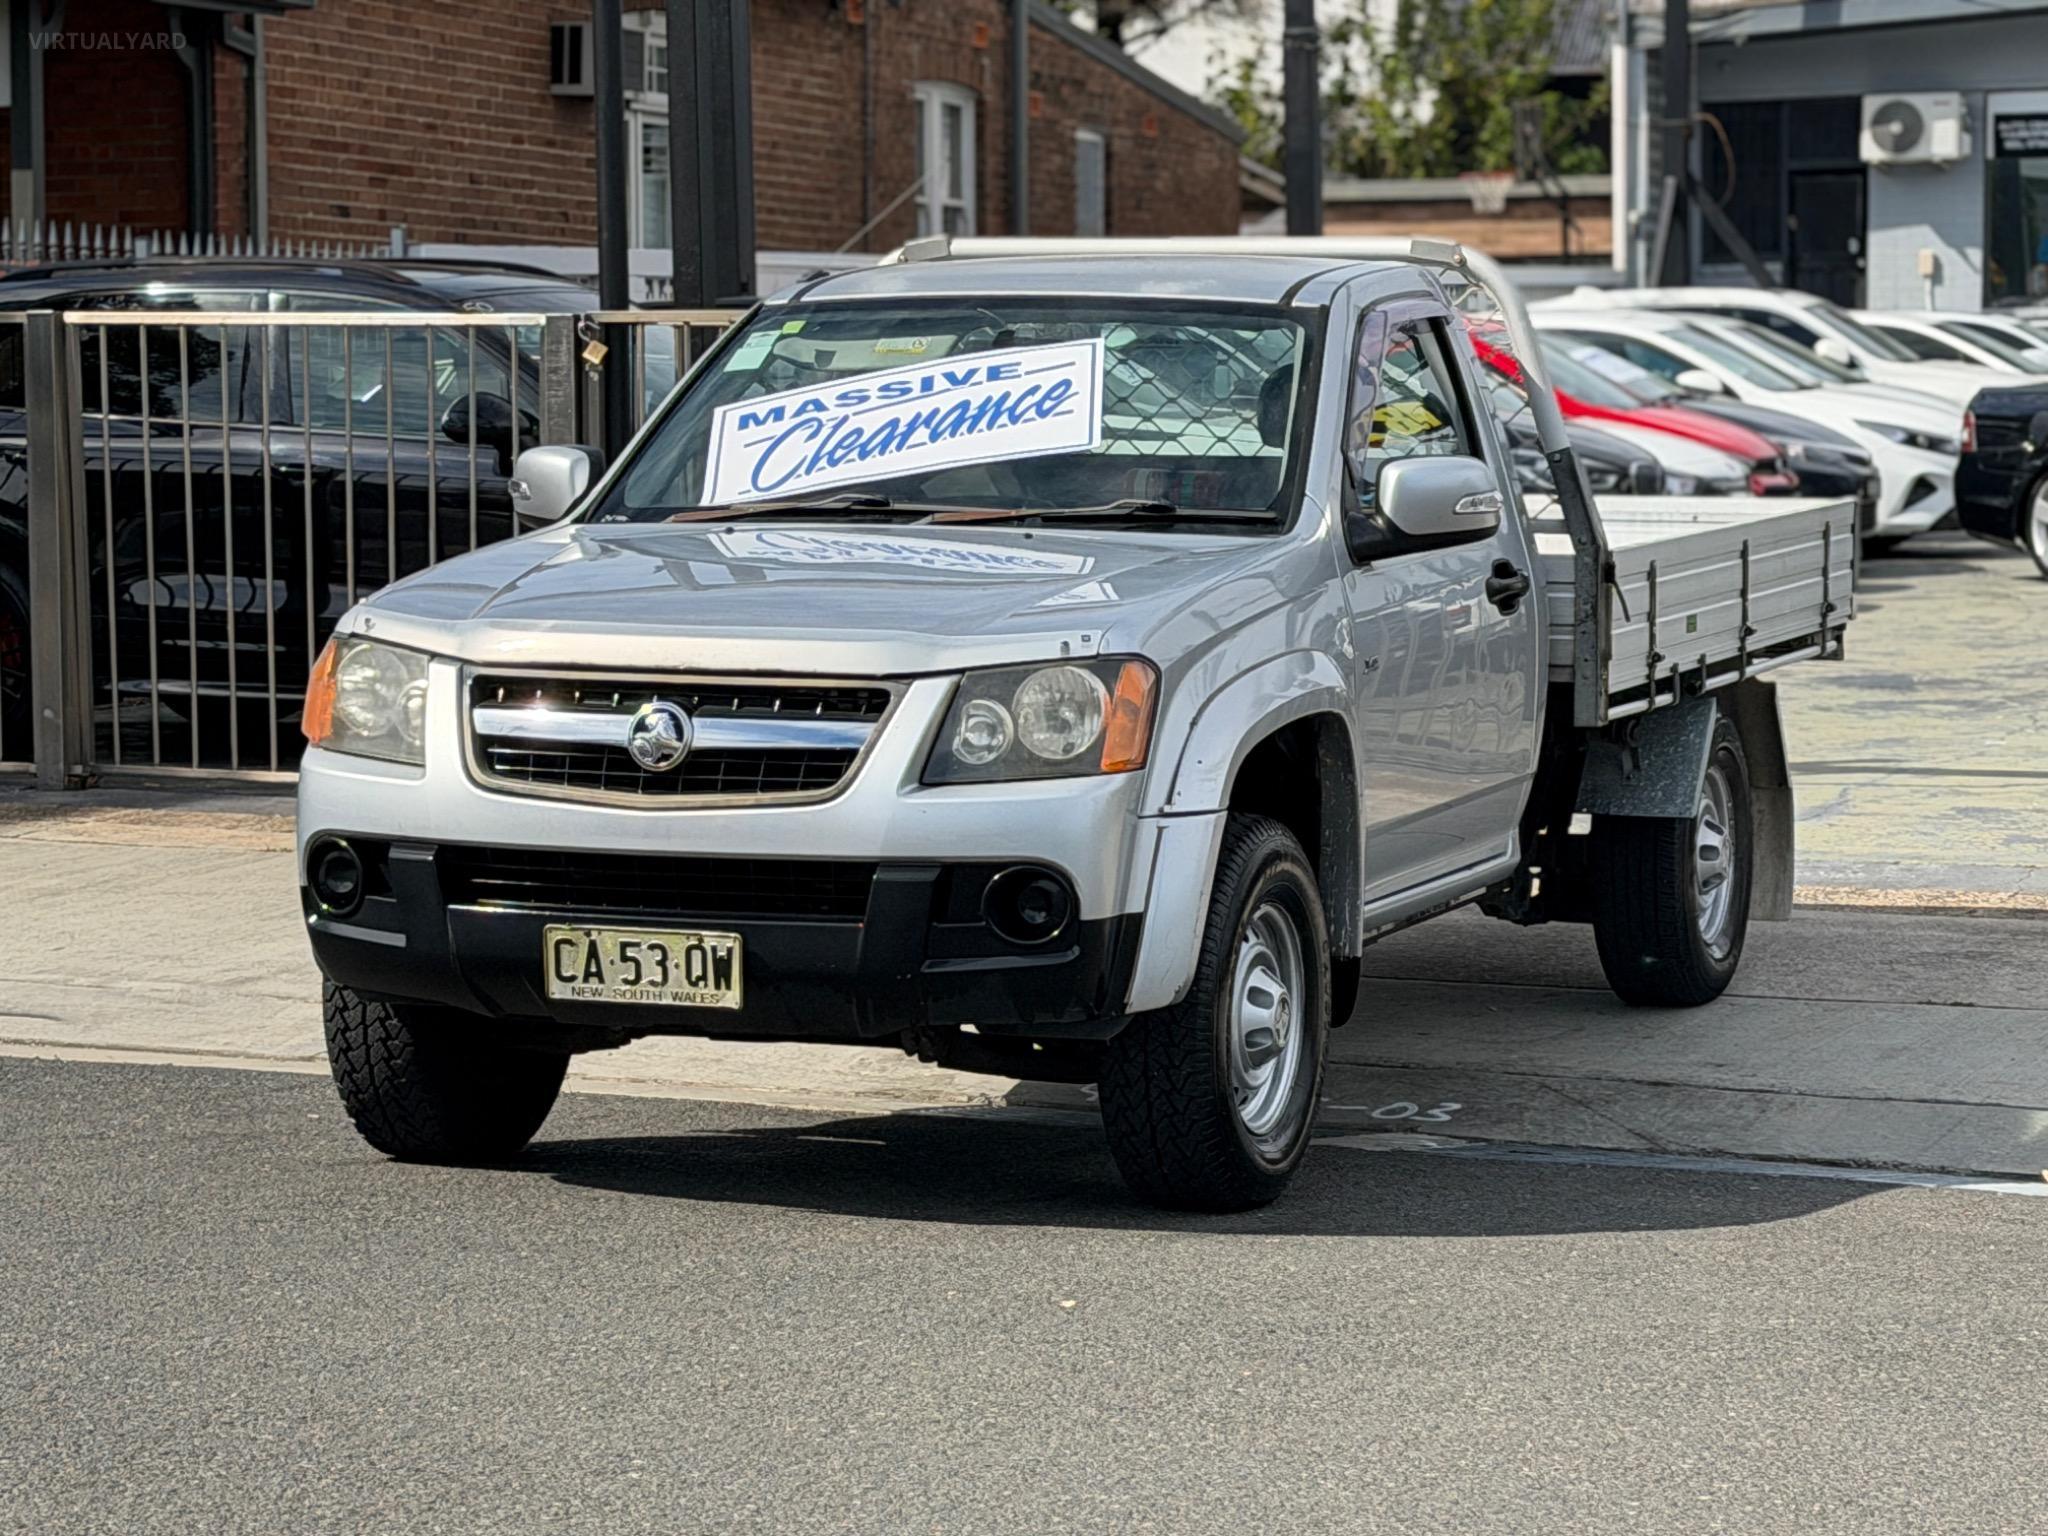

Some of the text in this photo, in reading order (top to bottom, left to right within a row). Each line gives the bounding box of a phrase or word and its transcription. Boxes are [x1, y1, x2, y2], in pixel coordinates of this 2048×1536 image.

[737, 361, 1022, 432] MASSIVE
[751, 378, 1073, 493] Clearance
[571, 986, 720, 1004] NEW SOUTH WALES
